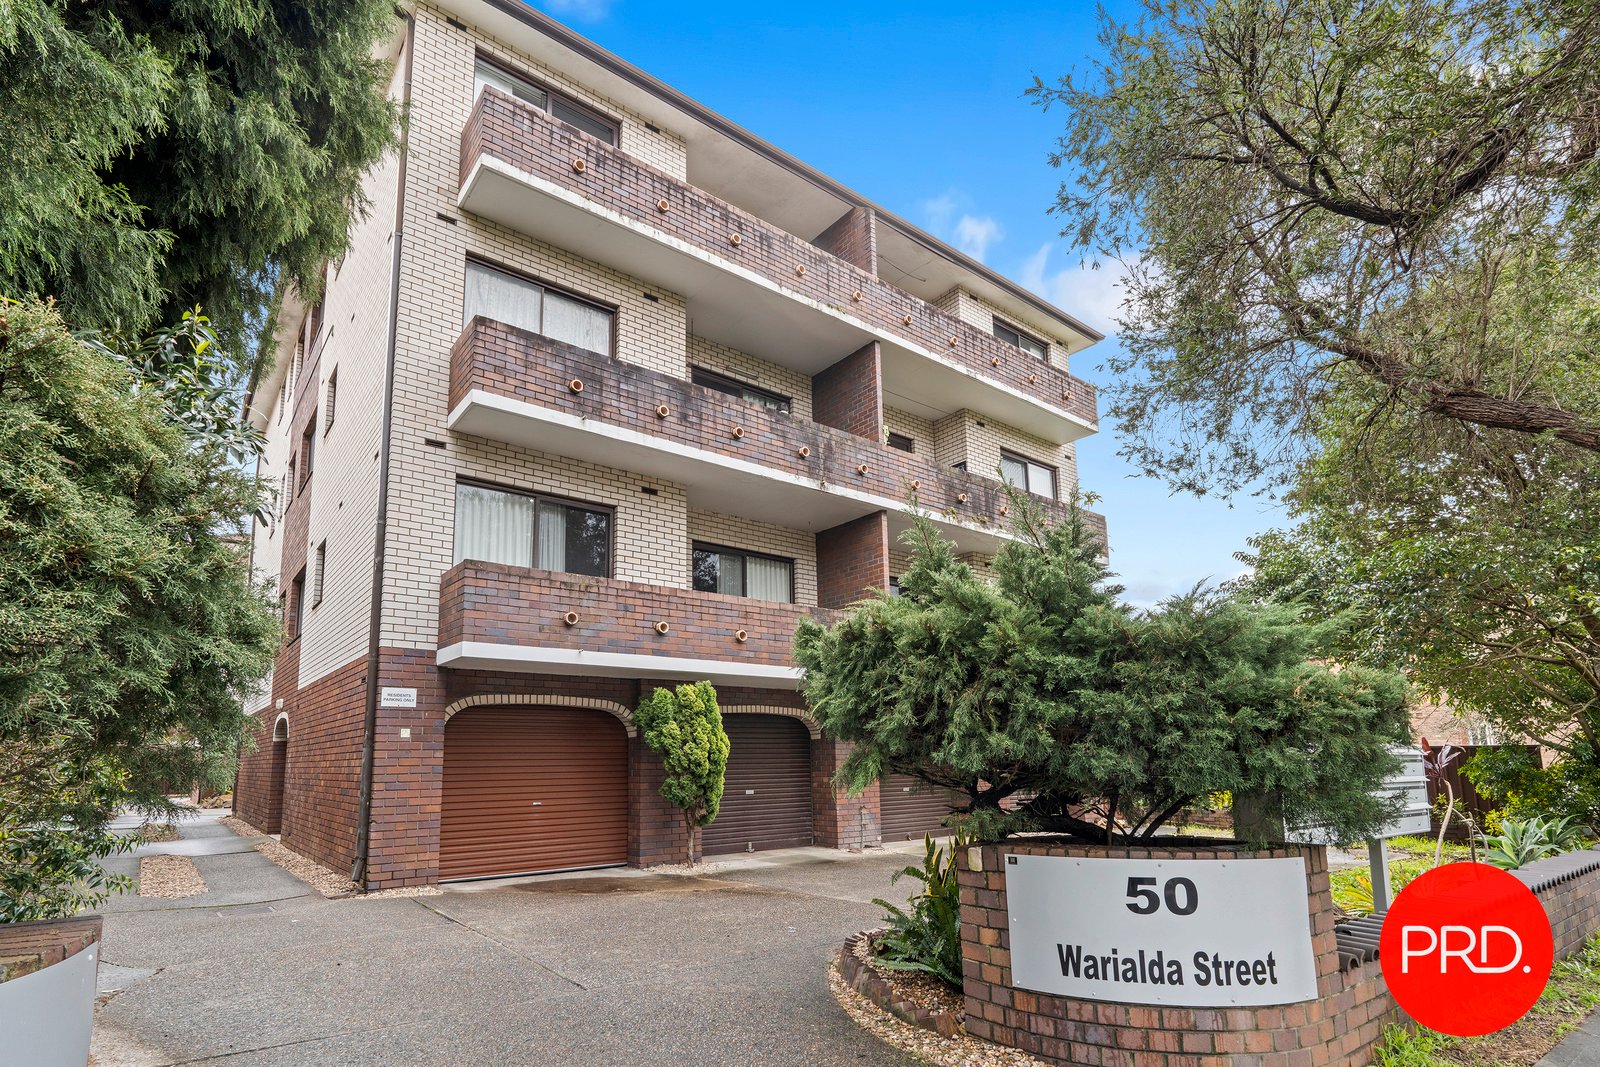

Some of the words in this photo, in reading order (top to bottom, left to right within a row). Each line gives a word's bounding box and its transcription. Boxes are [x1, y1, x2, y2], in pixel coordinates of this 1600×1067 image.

[1125, 876, 1199, 916] 50
[1056, 943, 1184, 986] Warialda
[1192, 950, 1278, 986] Street
